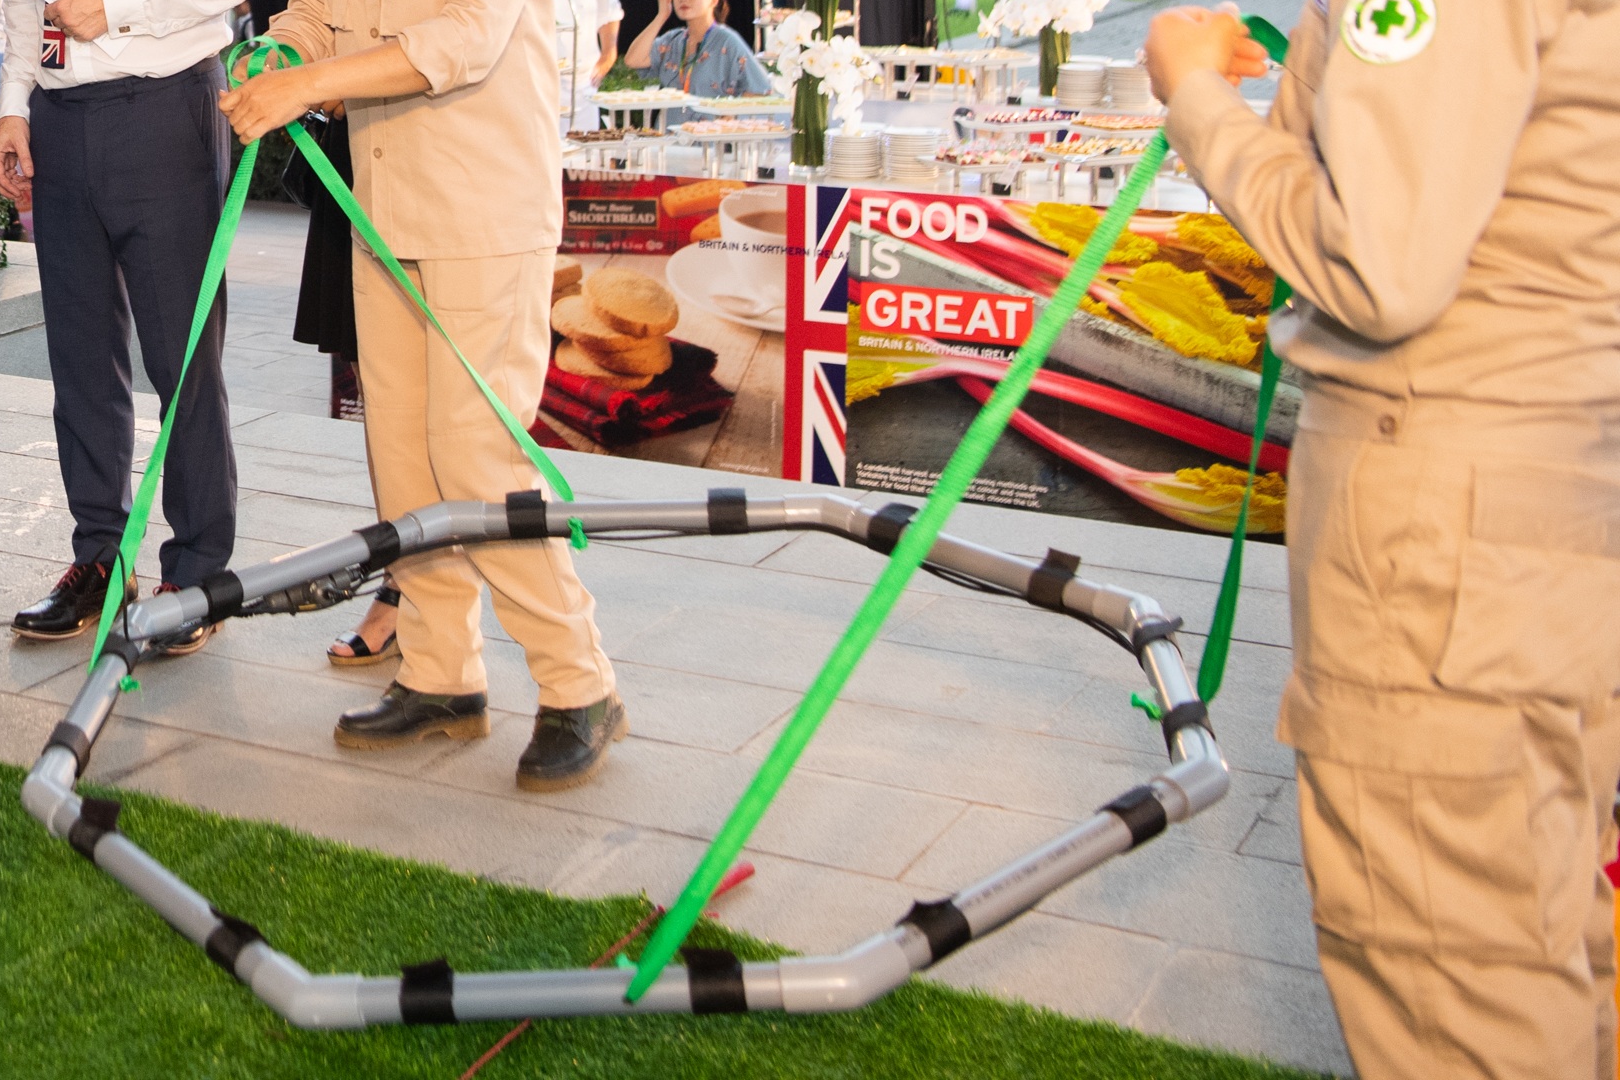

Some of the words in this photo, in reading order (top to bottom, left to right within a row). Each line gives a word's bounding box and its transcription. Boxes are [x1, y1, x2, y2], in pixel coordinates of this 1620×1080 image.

[861, 197, 988, 243] FOOD
[698, 239, 739, 251] BRITAIN
[742, 243, 749, 252] &
[752, 244, 809, 256] NORTHERN
[813, 248, 850, 260] IRELA
[860, 240, 901, 279] IS
[866, 289, 1027, 340] GREAT
[858, 335, 902, 351] BRITAIN
[904, 340, 913, 352] &
[915, 342, 978, 358] NORTHERN
[981, 347, 1017, 361] IRELA
